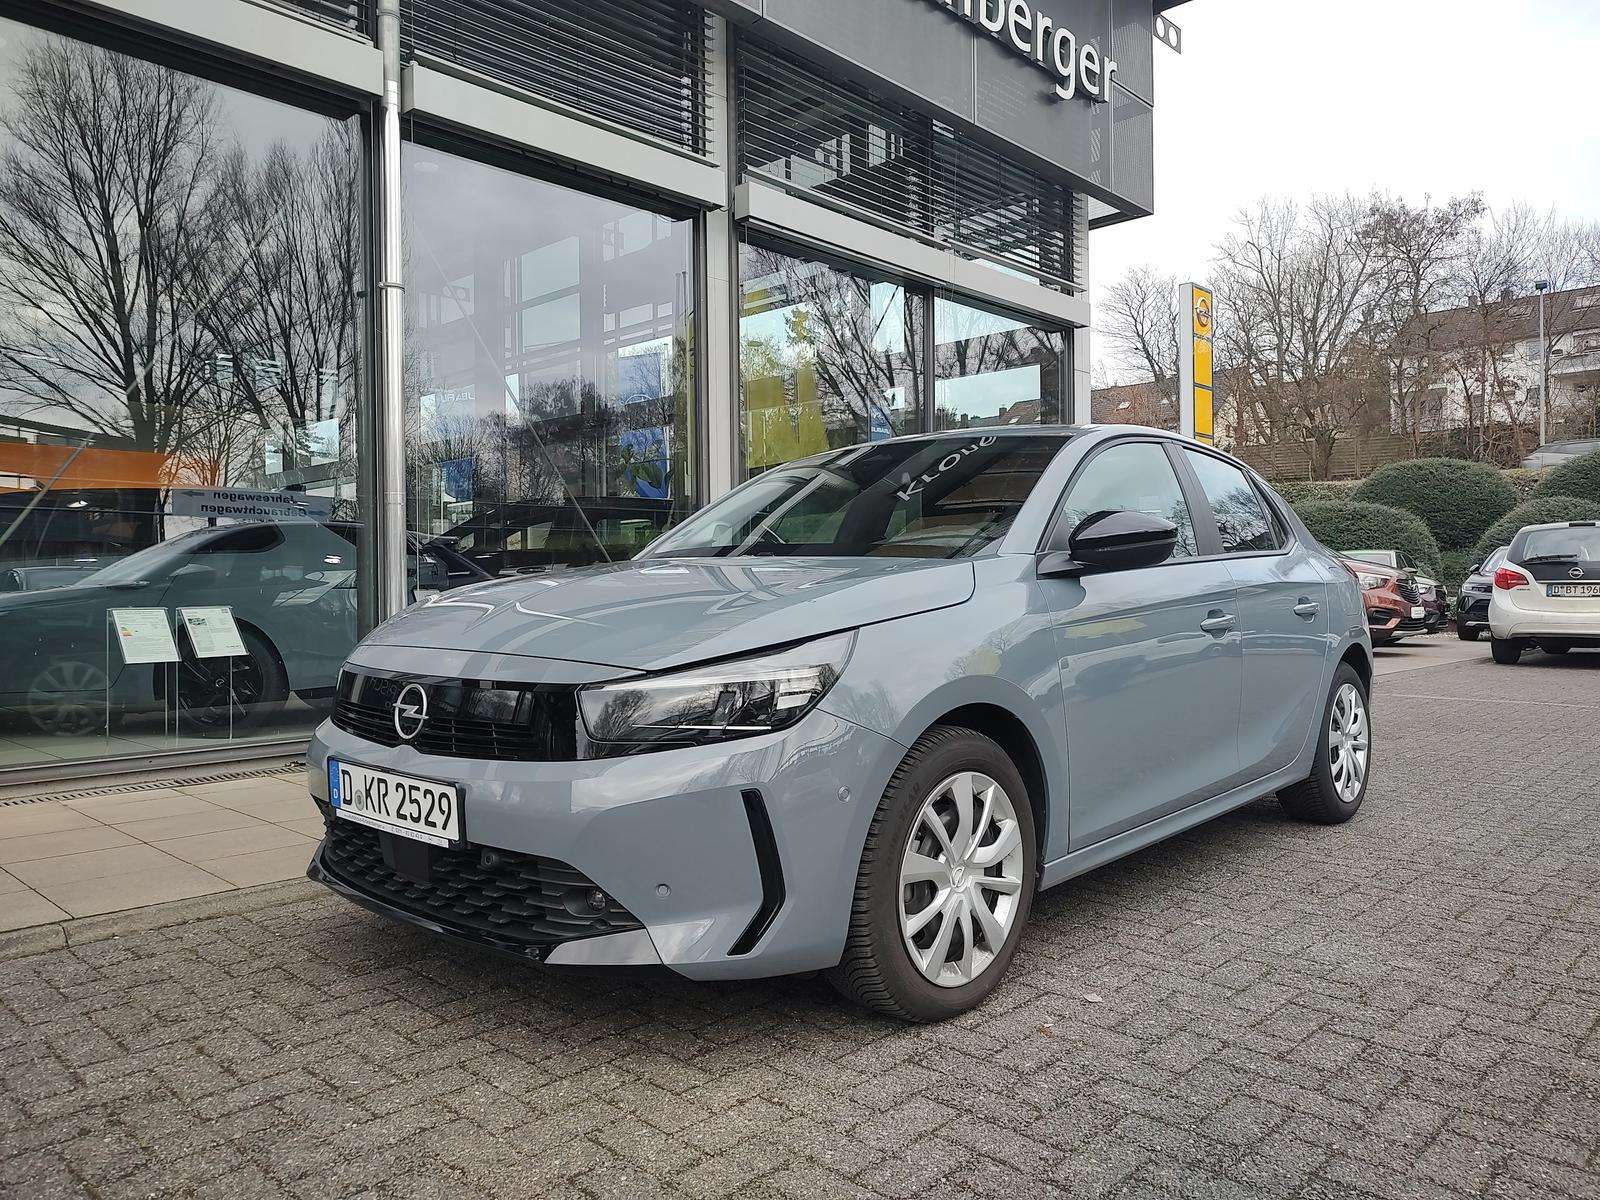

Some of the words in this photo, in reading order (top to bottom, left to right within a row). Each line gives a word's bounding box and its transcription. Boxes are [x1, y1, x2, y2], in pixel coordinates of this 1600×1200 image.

[944, 0, 1118, 103] erger
[1565, 585, 1578, 594] BT
[341, 769, 353, 806] D
[364, 774, 391, 817] KR
[395, 782, 452, 831] 2529
